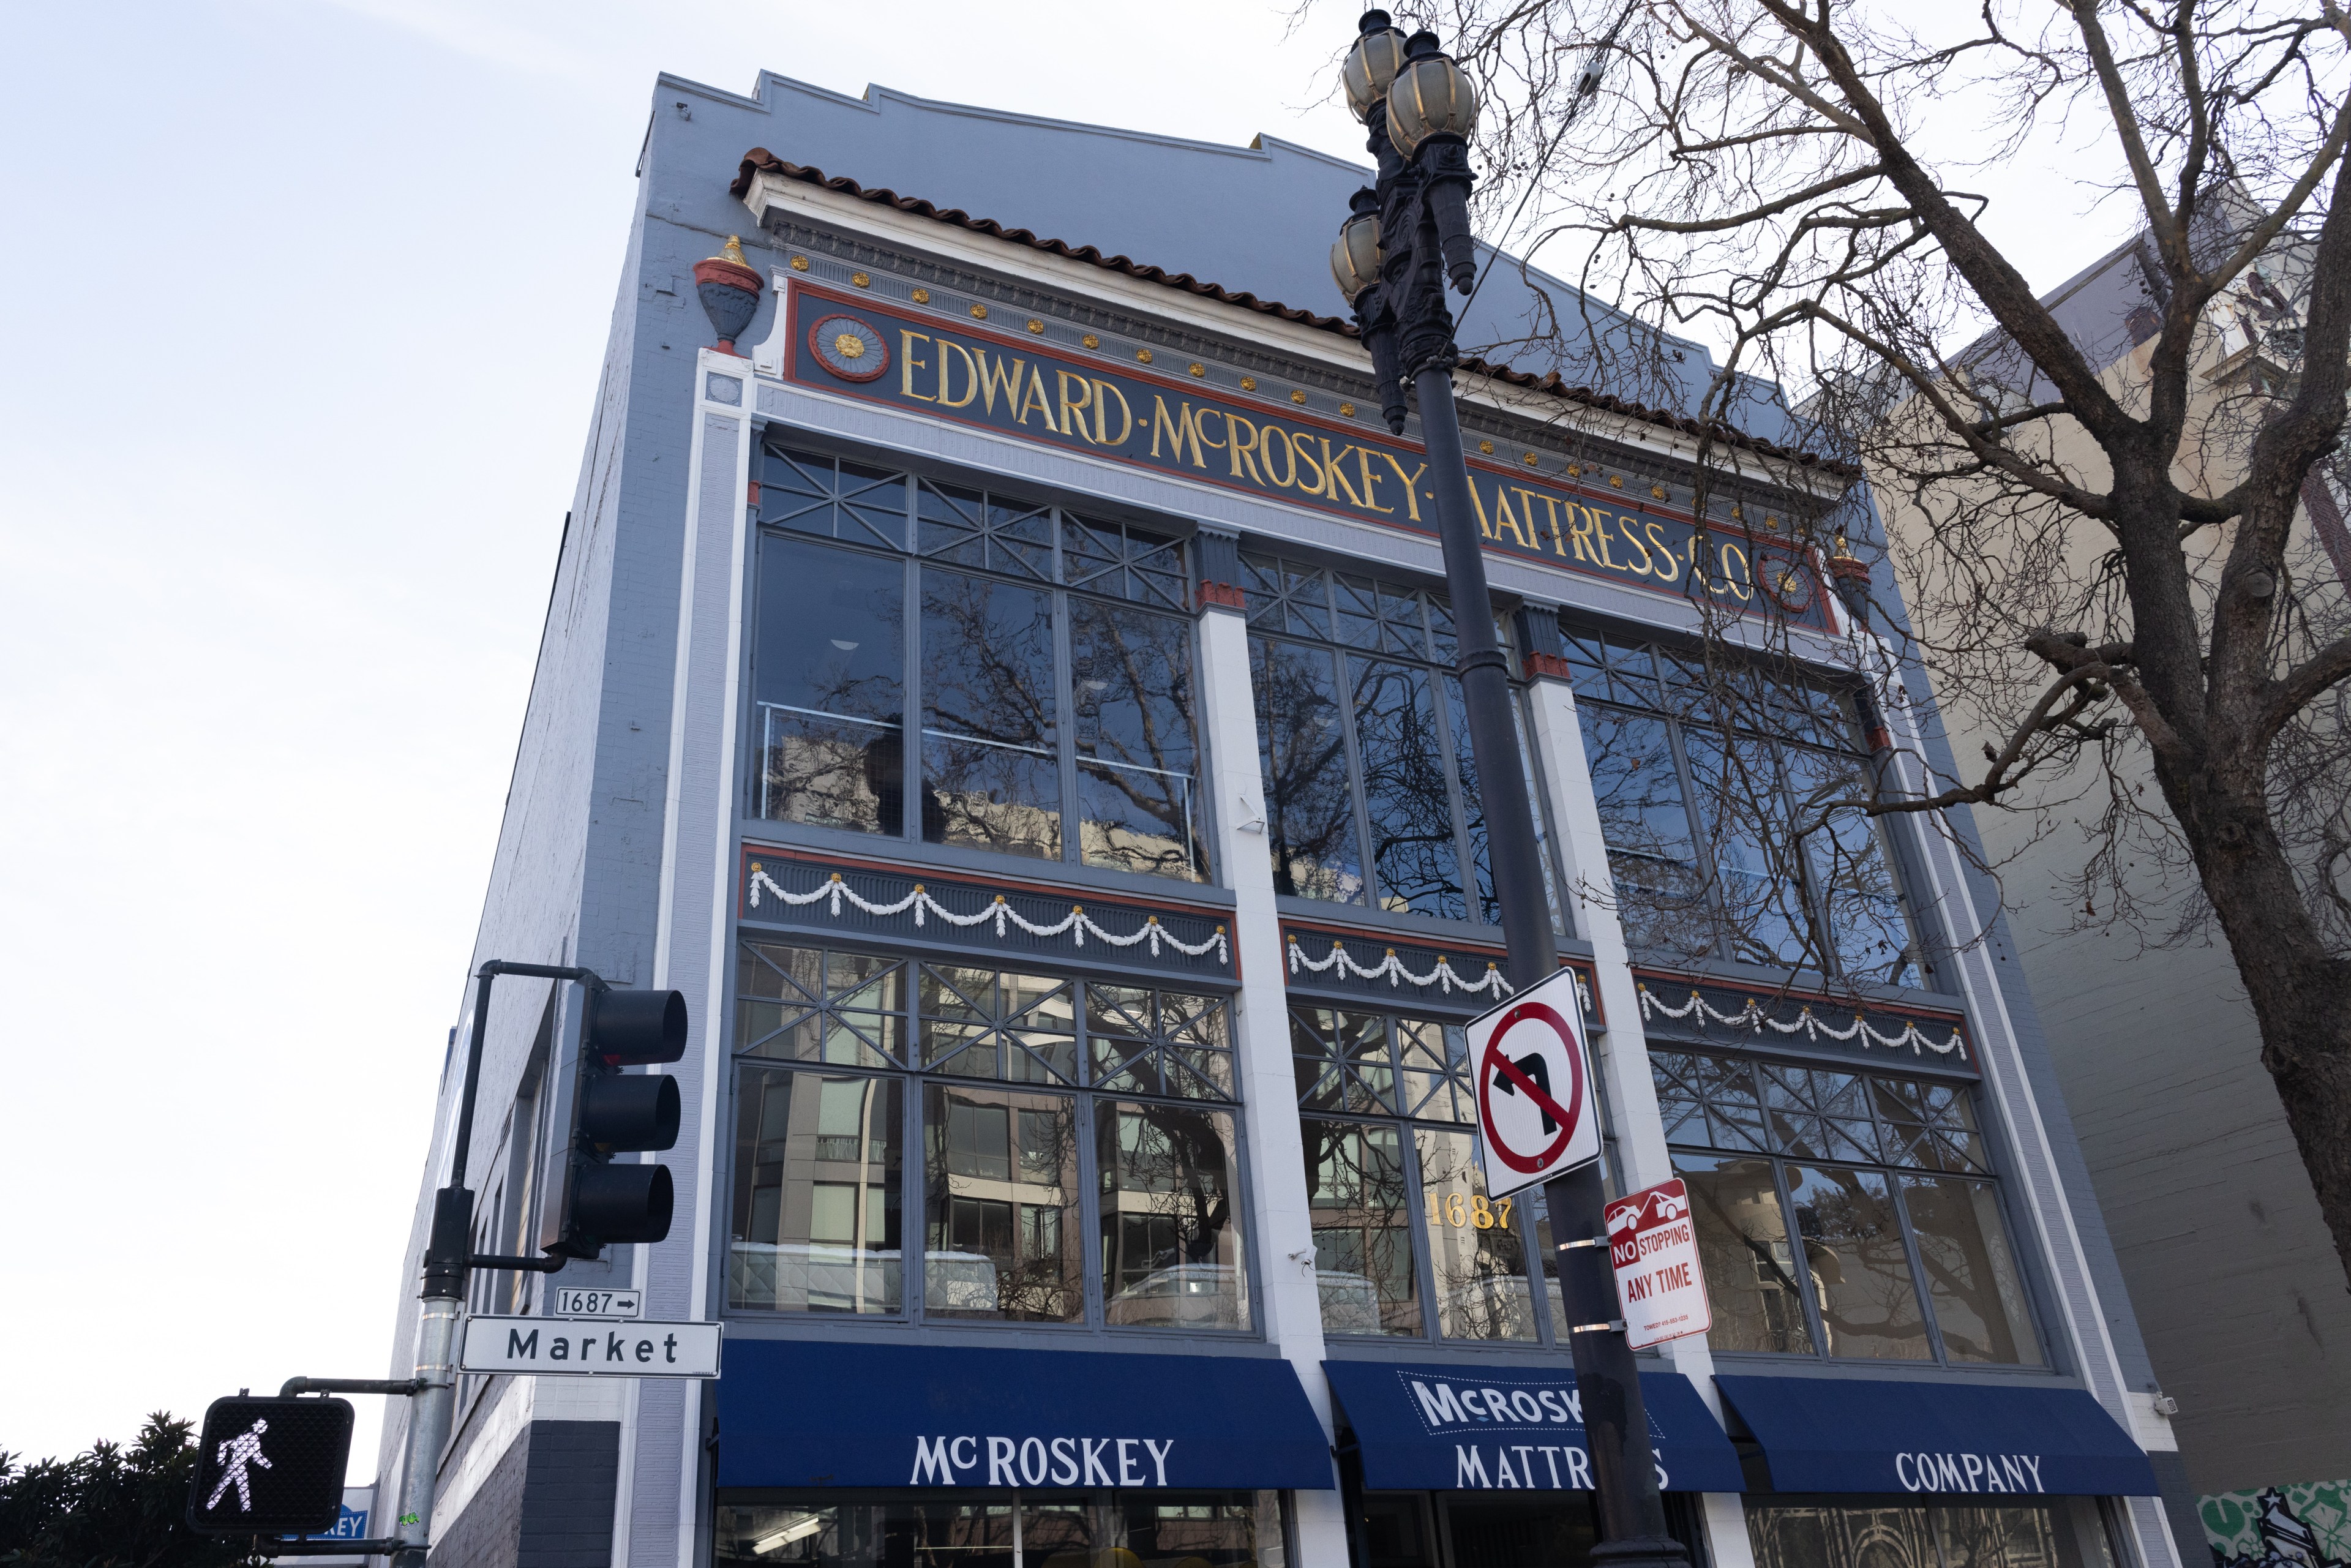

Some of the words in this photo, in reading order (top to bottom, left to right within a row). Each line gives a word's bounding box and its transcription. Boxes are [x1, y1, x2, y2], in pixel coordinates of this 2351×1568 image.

[899, 328, 1132, 446] EDWARD
[1428, 1191, 1513, 1230] 1687
[1613, 1240, 1637, 1265] NO
[1639, 1223, 1690, 1256] STOPPING
[562, 1291, 613, 1313] 1687
[1627, 1273, 1652, 1304] ANY
[1656, 1262, 1692, 1294] TIME
[1643, 1321, 1661, 1331] TOWED?
[1662, 1314, 1689, 1326] 415-553-1235
[507, 1328, 678, 1364] Market
[1895, 1452, 2045, 1493] COMPANY
